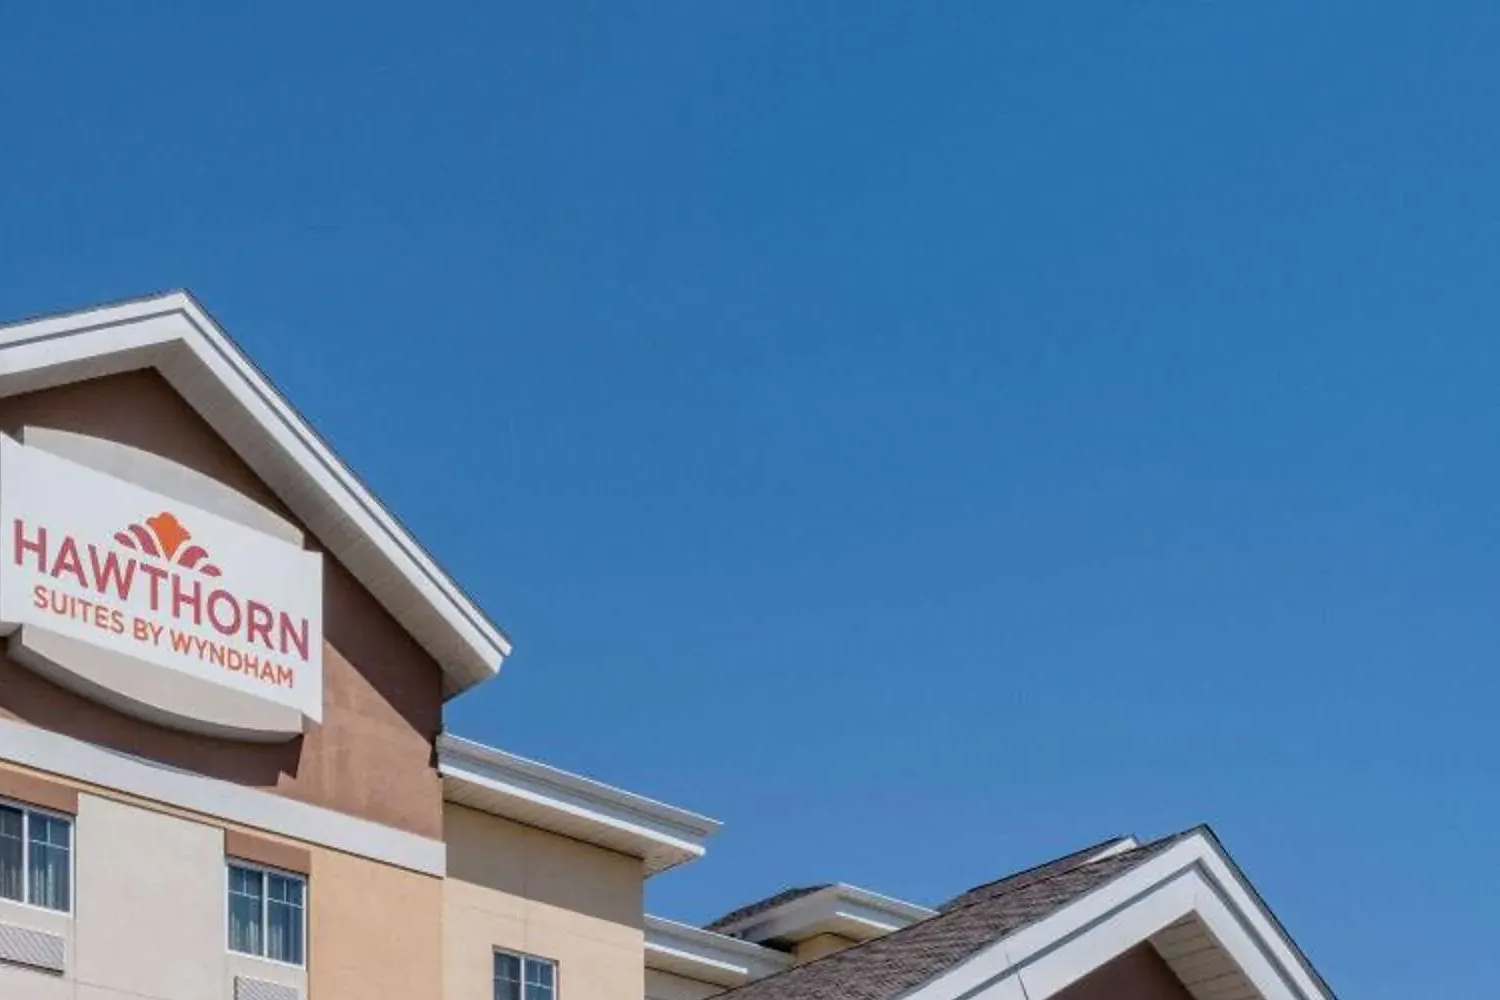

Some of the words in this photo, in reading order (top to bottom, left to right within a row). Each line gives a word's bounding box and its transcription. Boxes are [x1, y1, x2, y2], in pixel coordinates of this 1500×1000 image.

[13, 518, 309, 661] HAWTHORN
[34, 584, 125, 634] SUITES
[132, 617, 164, 645] BY
[169, 628, 295, 689] WYNDHAM
